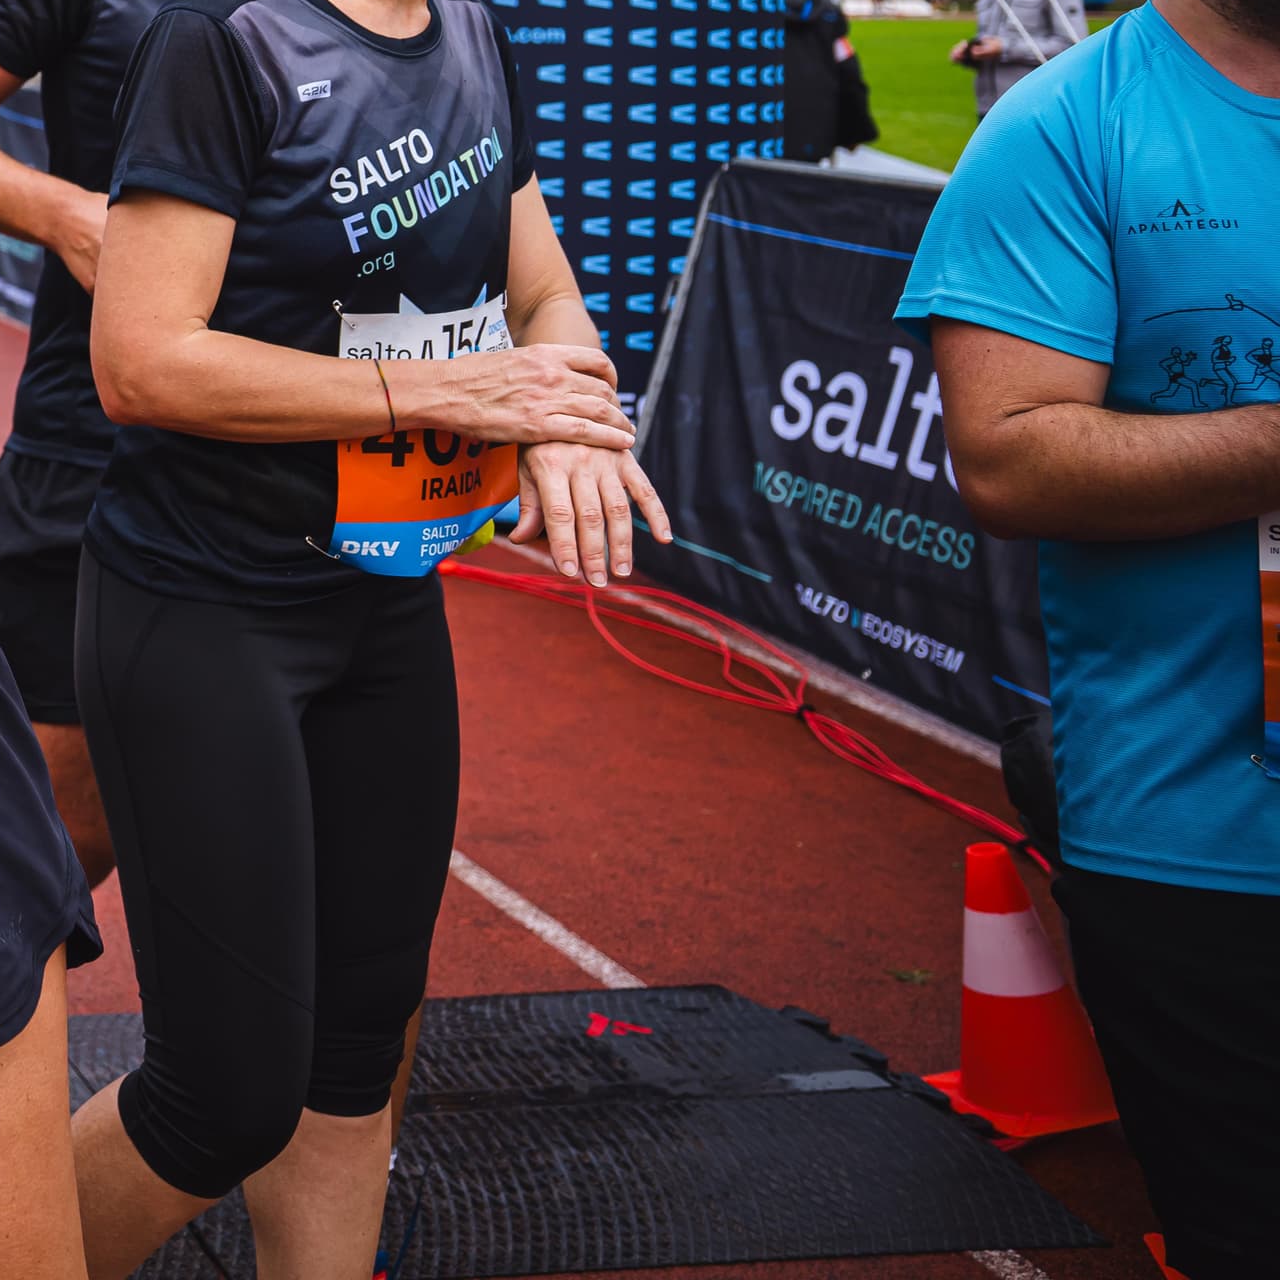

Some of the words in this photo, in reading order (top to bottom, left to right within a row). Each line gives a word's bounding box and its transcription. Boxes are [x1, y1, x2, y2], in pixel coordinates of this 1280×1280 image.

[302, 84, 328, 97] 42K
[329, 128, 434, 204] SALTO
[342, 126, 504, 254] FOUNDATION
[1127, 218, 1240, 236] APALATEGUI
[356, 250, 396, 278] .org
[347, 341, 412, 361] salto
[769, 344, 960, 495] salt
[420, 466, 482, 502] IRAIDA
[422, 523, 459, 541] SALTO
[862, 502, 976, 570] ACCESS
[340, 540, 401, 558] DKV
[860, 611, 966, 674] ECOSYSTEM
